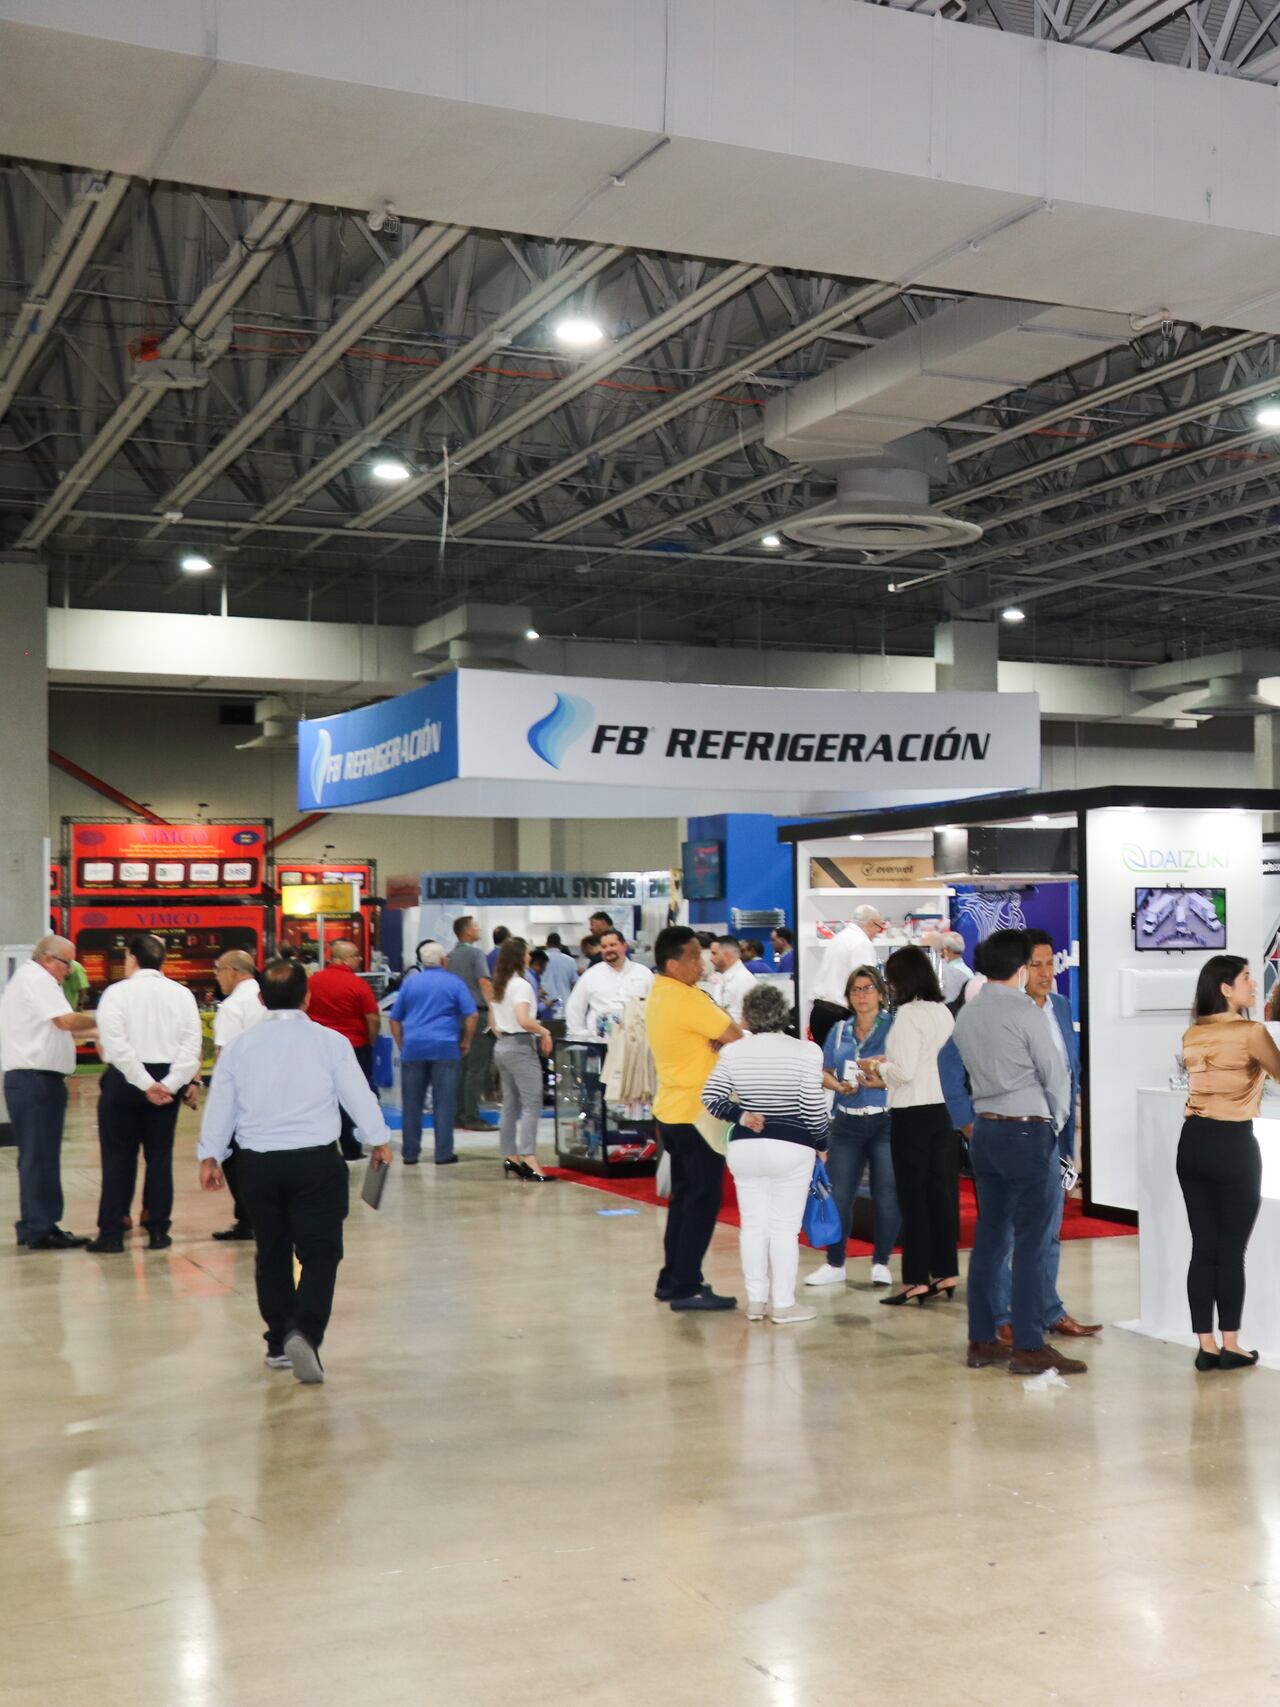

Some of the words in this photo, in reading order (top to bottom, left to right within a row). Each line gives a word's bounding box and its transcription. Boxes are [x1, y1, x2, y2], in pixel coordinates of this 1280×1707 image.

[325, 752, 344, 784] FB
[343, 718, 442, 781] REFRIGERACIÓN
[592, 723, 648, 756] FB
[664, 726, 993, 762] REFRIGERACIÓN
[427, 876, 472, 900] LIGHT
[474, 876, 568, 900] COMMERCIAL
[571, 876, 637, 900] SYSTEMS
[136, 912, 201, 926] VIMCO
